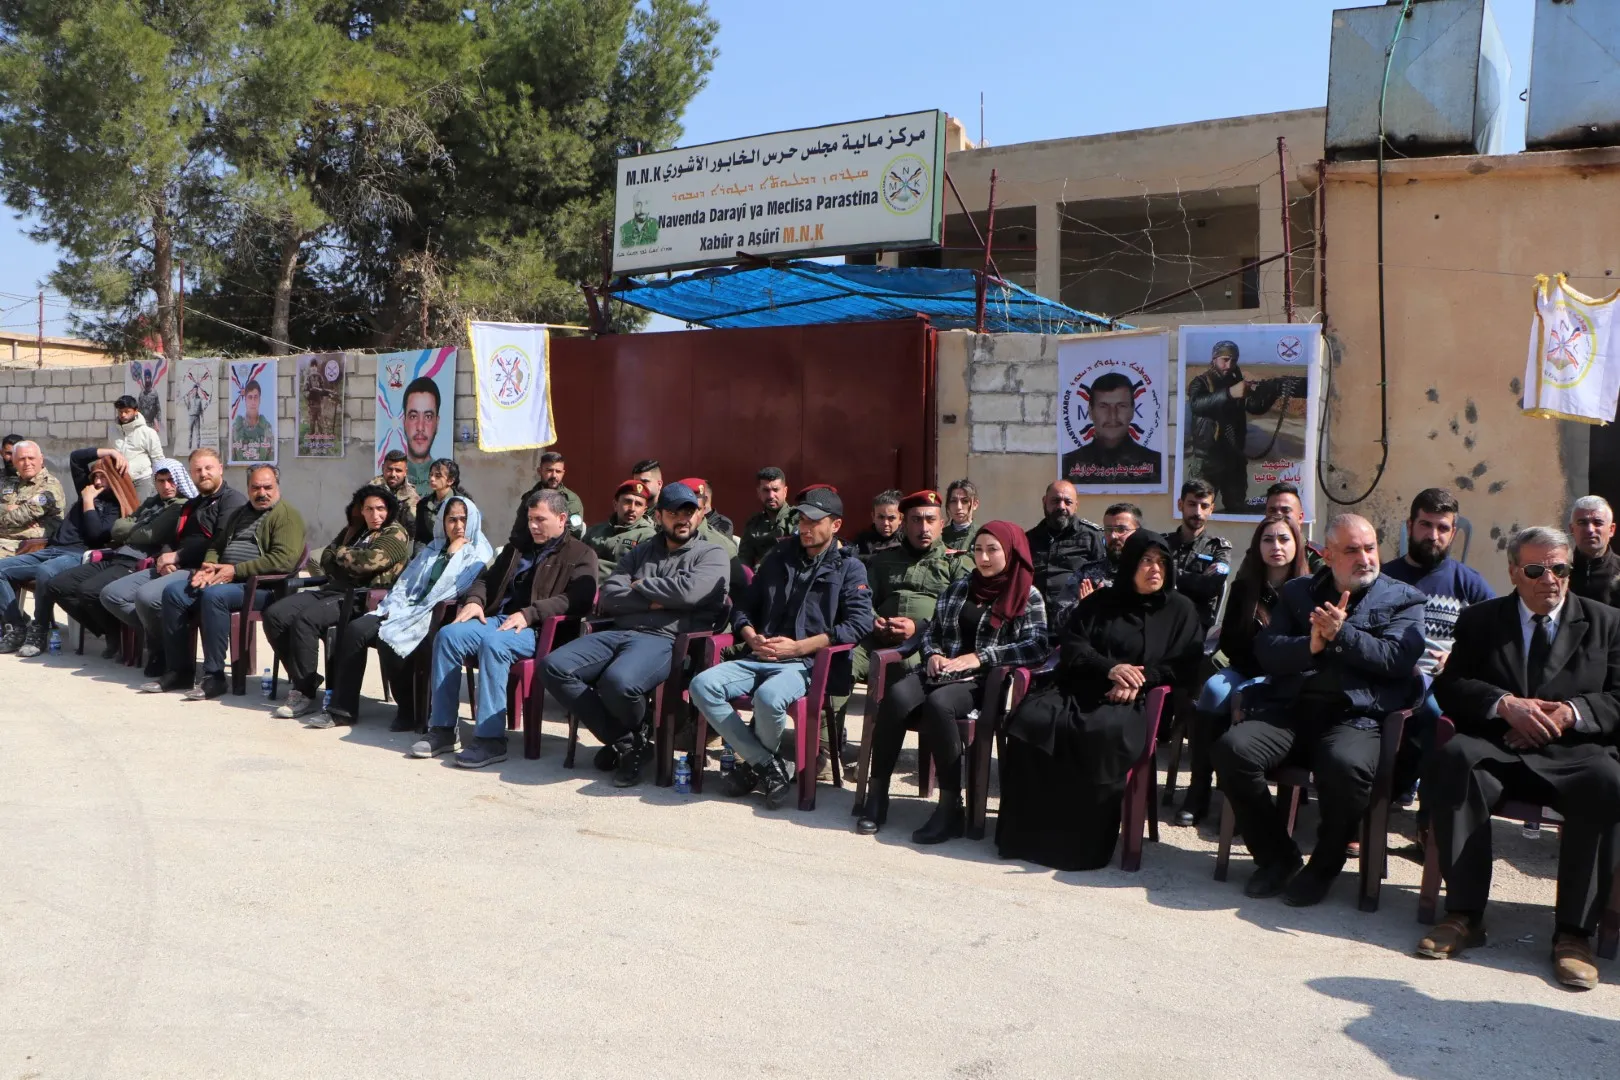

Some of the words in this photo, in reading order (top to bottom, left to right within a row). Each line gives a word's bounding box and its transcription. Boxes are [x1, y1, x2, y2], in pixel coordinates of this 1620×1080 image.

[842, 132, 883, 154] مالية
[885, 127, 926, 149] مركز
[710, 149, 760, 173] الخابور
[763, 148, 798, 166] حرس
[801, 140, 838, 161] مجلس
[626, 166, 661, 186] M.N.K
[658, 209, 706, 229] Navenda
[709, 203, 747, 222] Darayî
[750, 204, 763, 220] ya
[767, 197, 812, 216] Meclisa
[816, 190, 879, 210] Parastina
[699, 233, 734, 251] Xabûr
[737, 234, 744, 247] a
[783, 223, 824, 243] M.N.K
[1261, 458, 1294, 470] الشهيد
